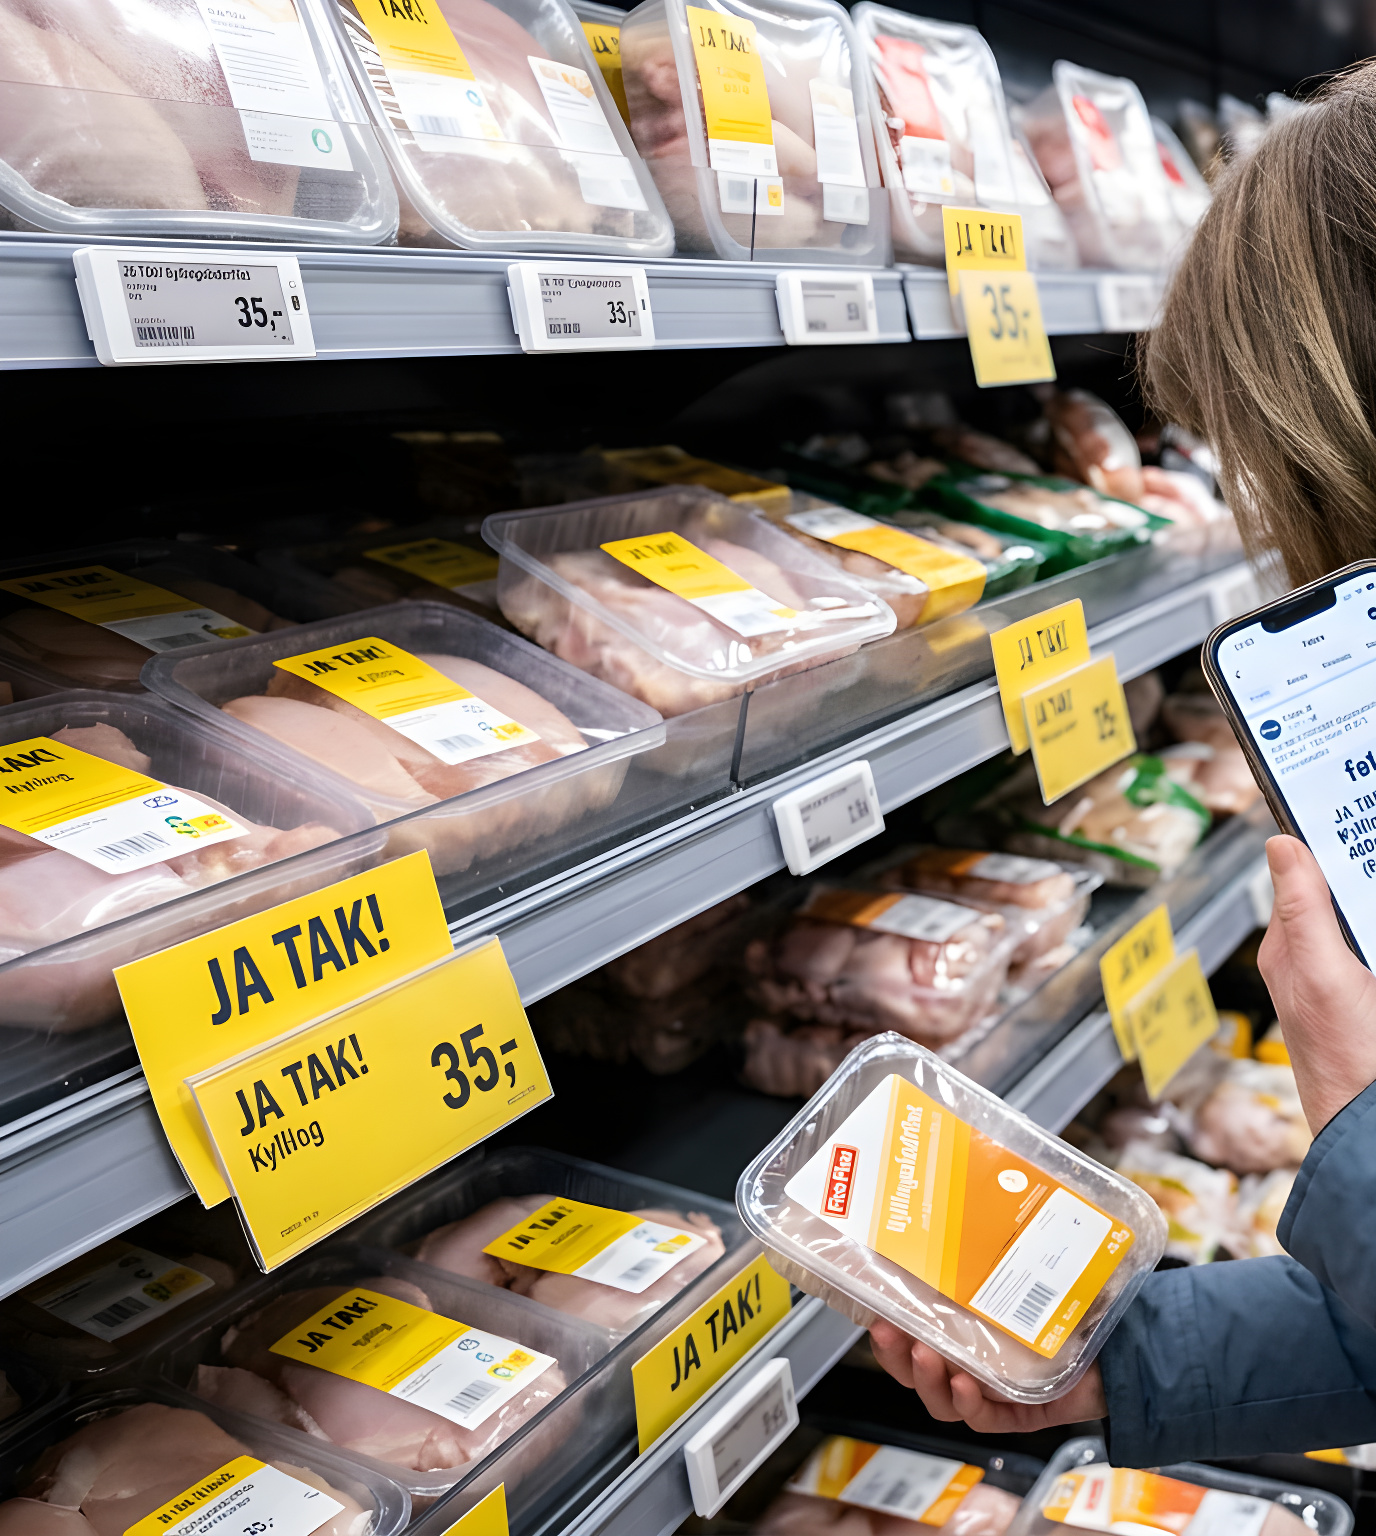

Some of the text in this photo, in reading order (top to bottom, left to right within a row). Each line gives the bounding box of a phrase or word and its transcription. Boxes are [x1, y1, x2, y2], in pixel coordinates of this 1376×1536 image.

[234, 296, 283, 331] 35,-
[207, 893, 391, 1026] JA TAK!
[235, 1023, 518, 1137] JA TAK! 35,-
[296, 1331, 333, 1353] JA
[670, 1272, 762, 1392] JA TAK!
